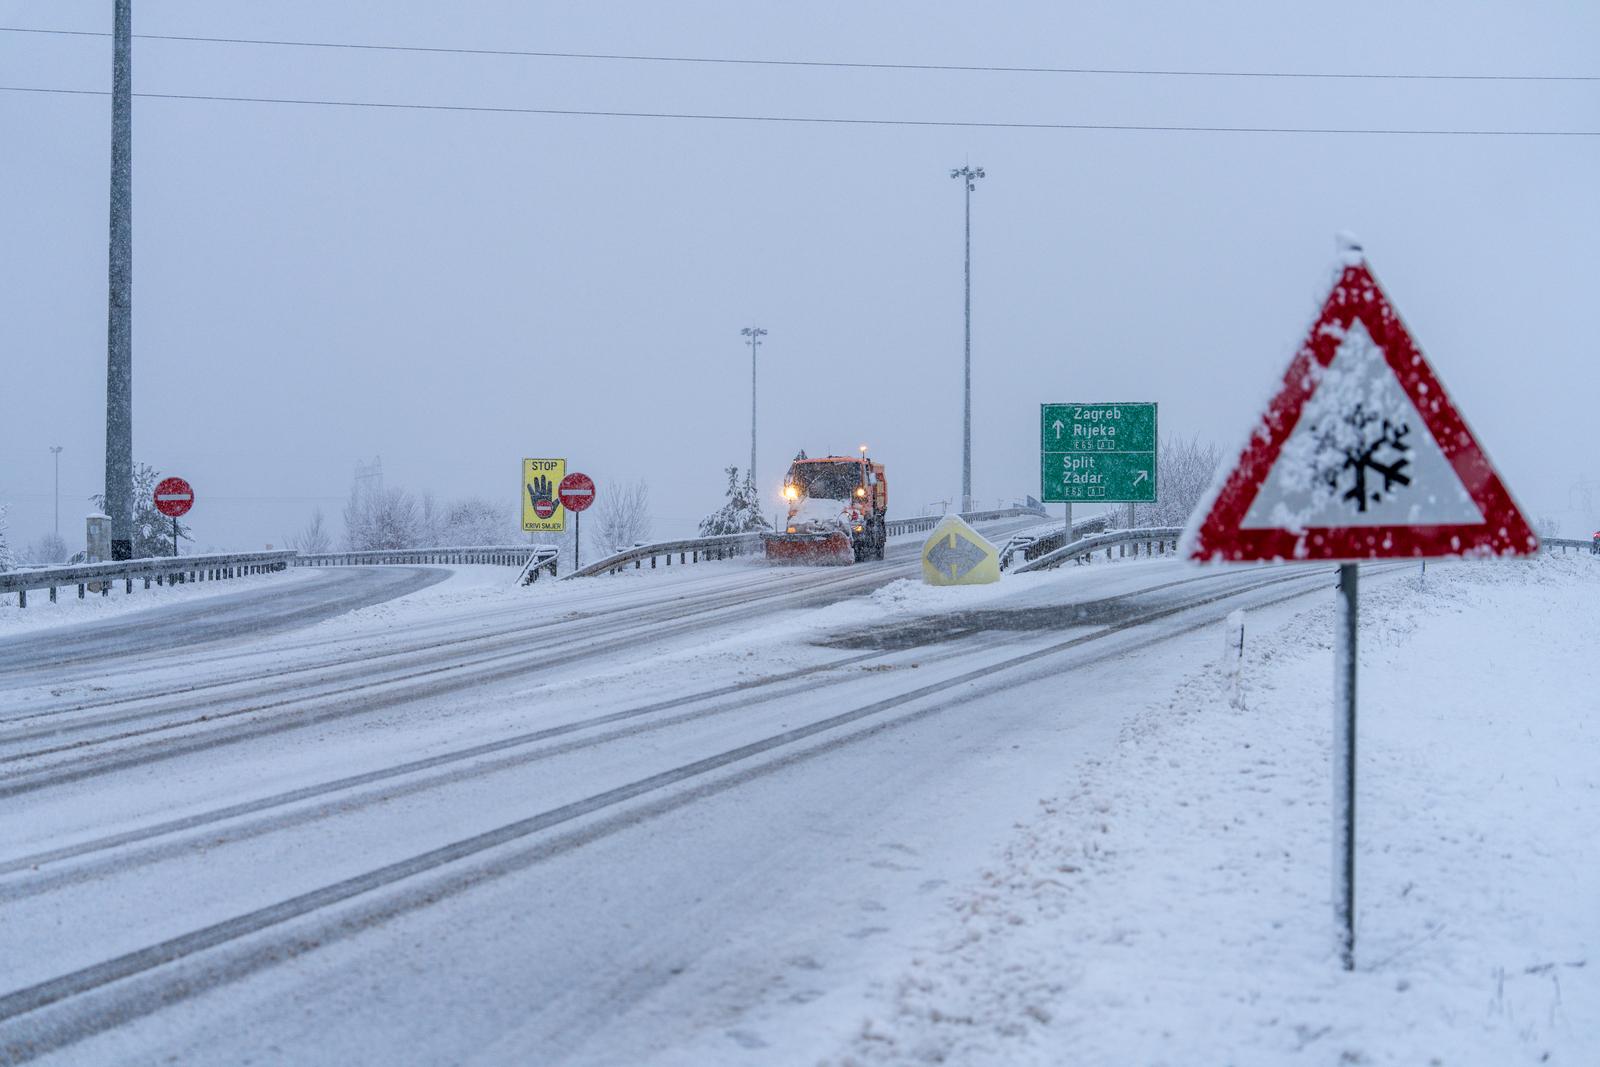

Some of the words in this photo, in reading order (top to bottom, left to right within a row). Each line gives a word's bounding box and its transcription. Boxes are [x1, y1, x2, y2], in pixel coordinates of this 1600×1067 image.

[1073, 407, 1121, 422] Zagreb
[1073, 424, 1116, 439] Rijeka
[531, 461, 558, 471] STOP
[1063, 456, 1095, 470] Split
[1062, 471, 1103, 484] Zadar
[541, 522, 562, 530] SMJER
